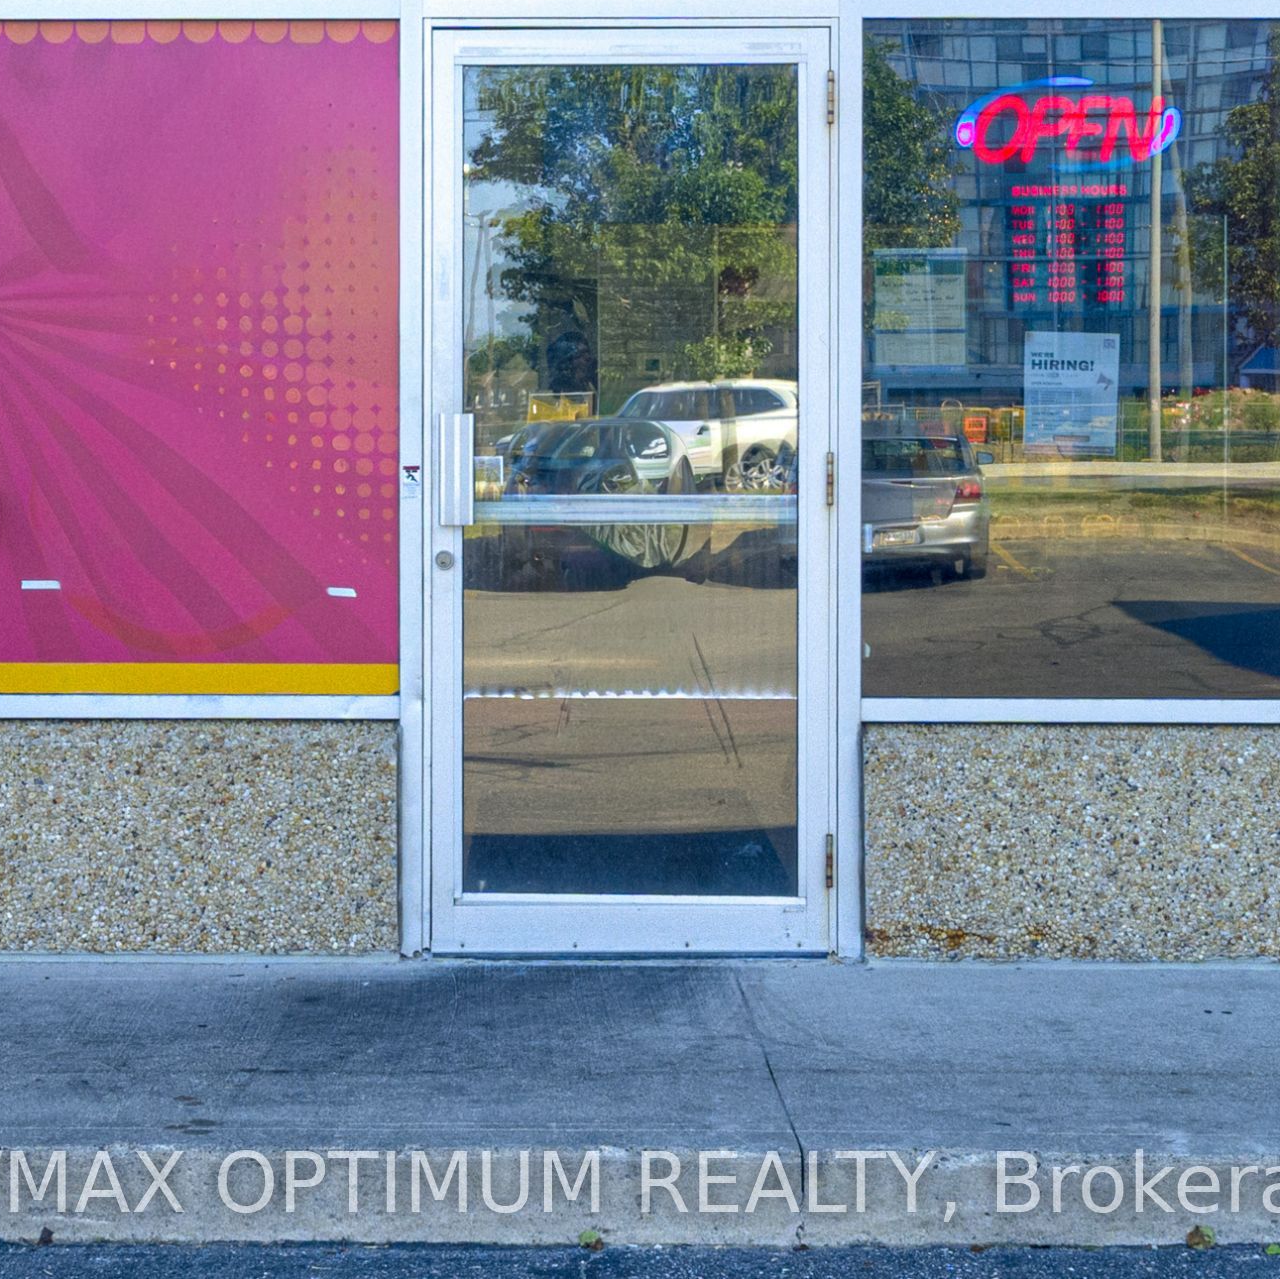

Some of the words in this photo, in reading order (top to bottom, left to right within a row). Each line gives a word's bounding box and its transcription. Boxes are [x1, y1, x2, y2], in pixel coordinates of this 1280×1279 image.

[972, 94, 1166, 165] OPEN
[1011, 185, 1078, 197] BUSINESS
[1080, 184, 1127, 197] HOURS
[1012, 205, 1036, 216] MON
[1012, 219, 1036, 230] TUE
[1012, 234, 1036, 245] WED
[1012, 248, 1036, 259] THU
[1012, 263, 1036, 274] FRI
[1012, 277, 1036, 288] SAT
[1012, 291, 1036, 302] SUN
[1031, 351, 1055, 359] WE'RE
[1031, 359, 1096, 372] HIRING!
